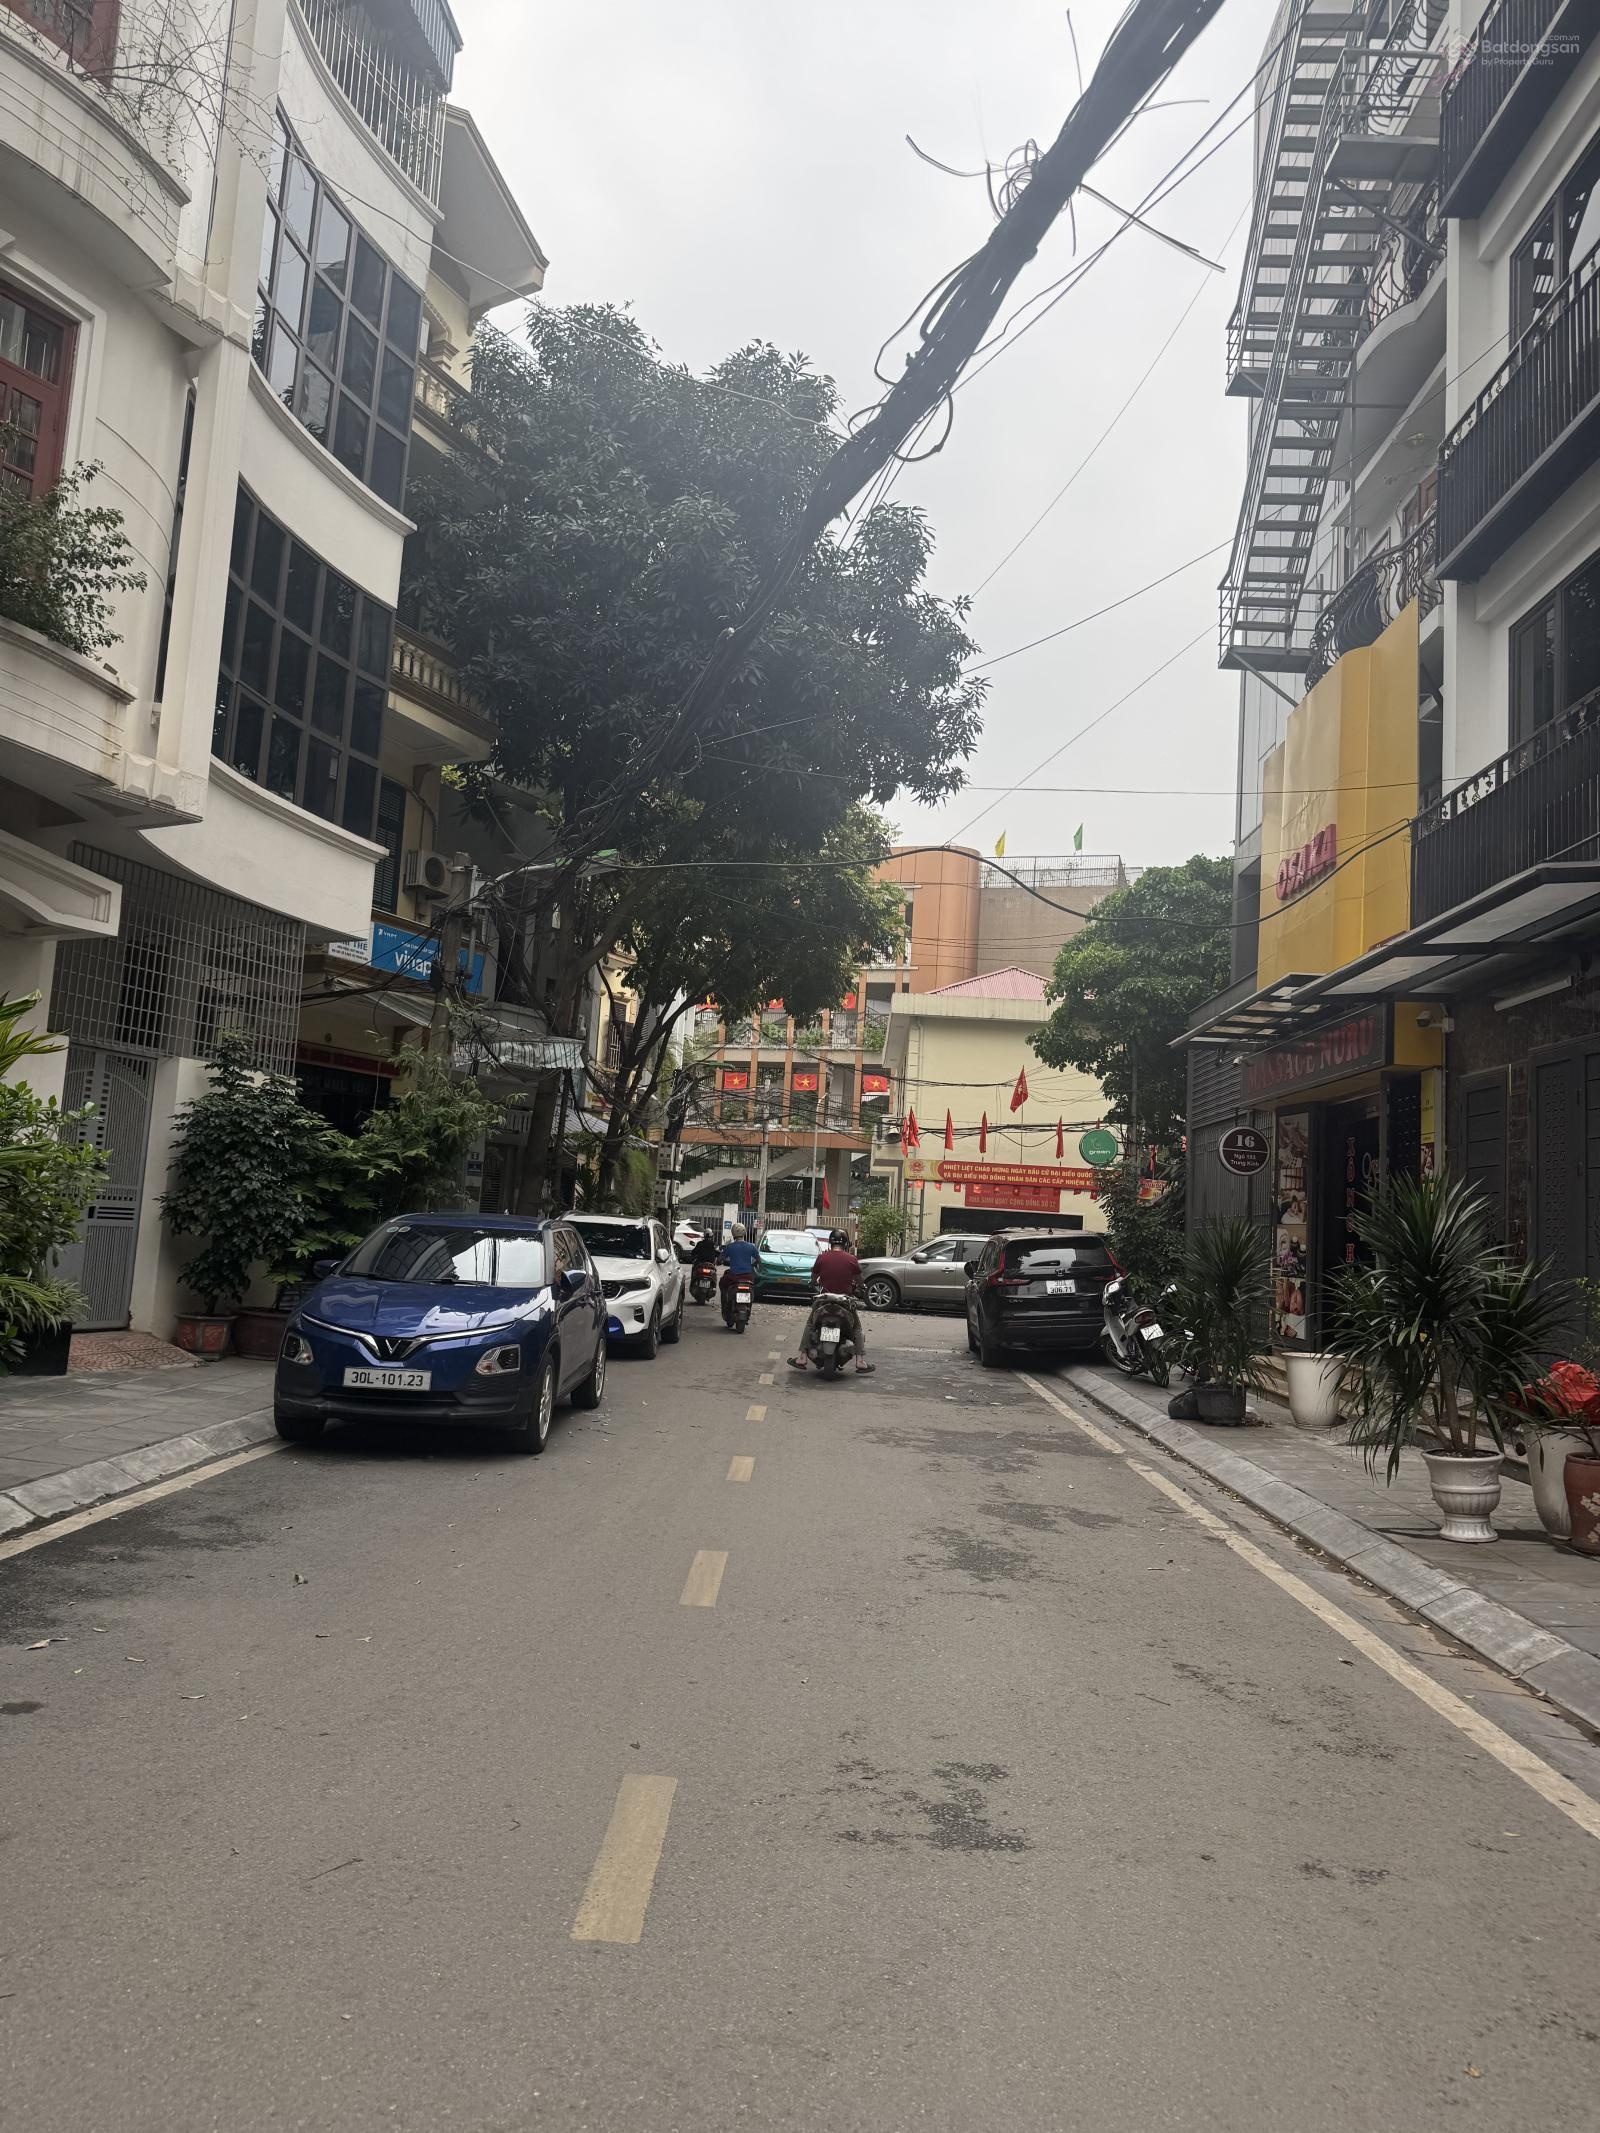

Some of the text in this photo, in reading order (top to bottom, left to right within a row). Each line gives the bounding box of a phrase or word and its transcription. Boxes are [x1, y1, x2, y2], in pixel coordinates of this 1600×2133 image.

[395, 950, 432, 976] vinap
[1247, 1016, 1376, 1089] MASSAGE NURU
[1234, 1134, 1256, 1148] 16
[961, 1164, 974, 1172] LIỆT
[1010, 1167, 1027, 1175] NGÀY
[1230, 1159, 1246, 1167] Trung
[1049, 1286, 1072, 1294] 306.71
[351, 1371, 424, 1387] 30L-101.23
